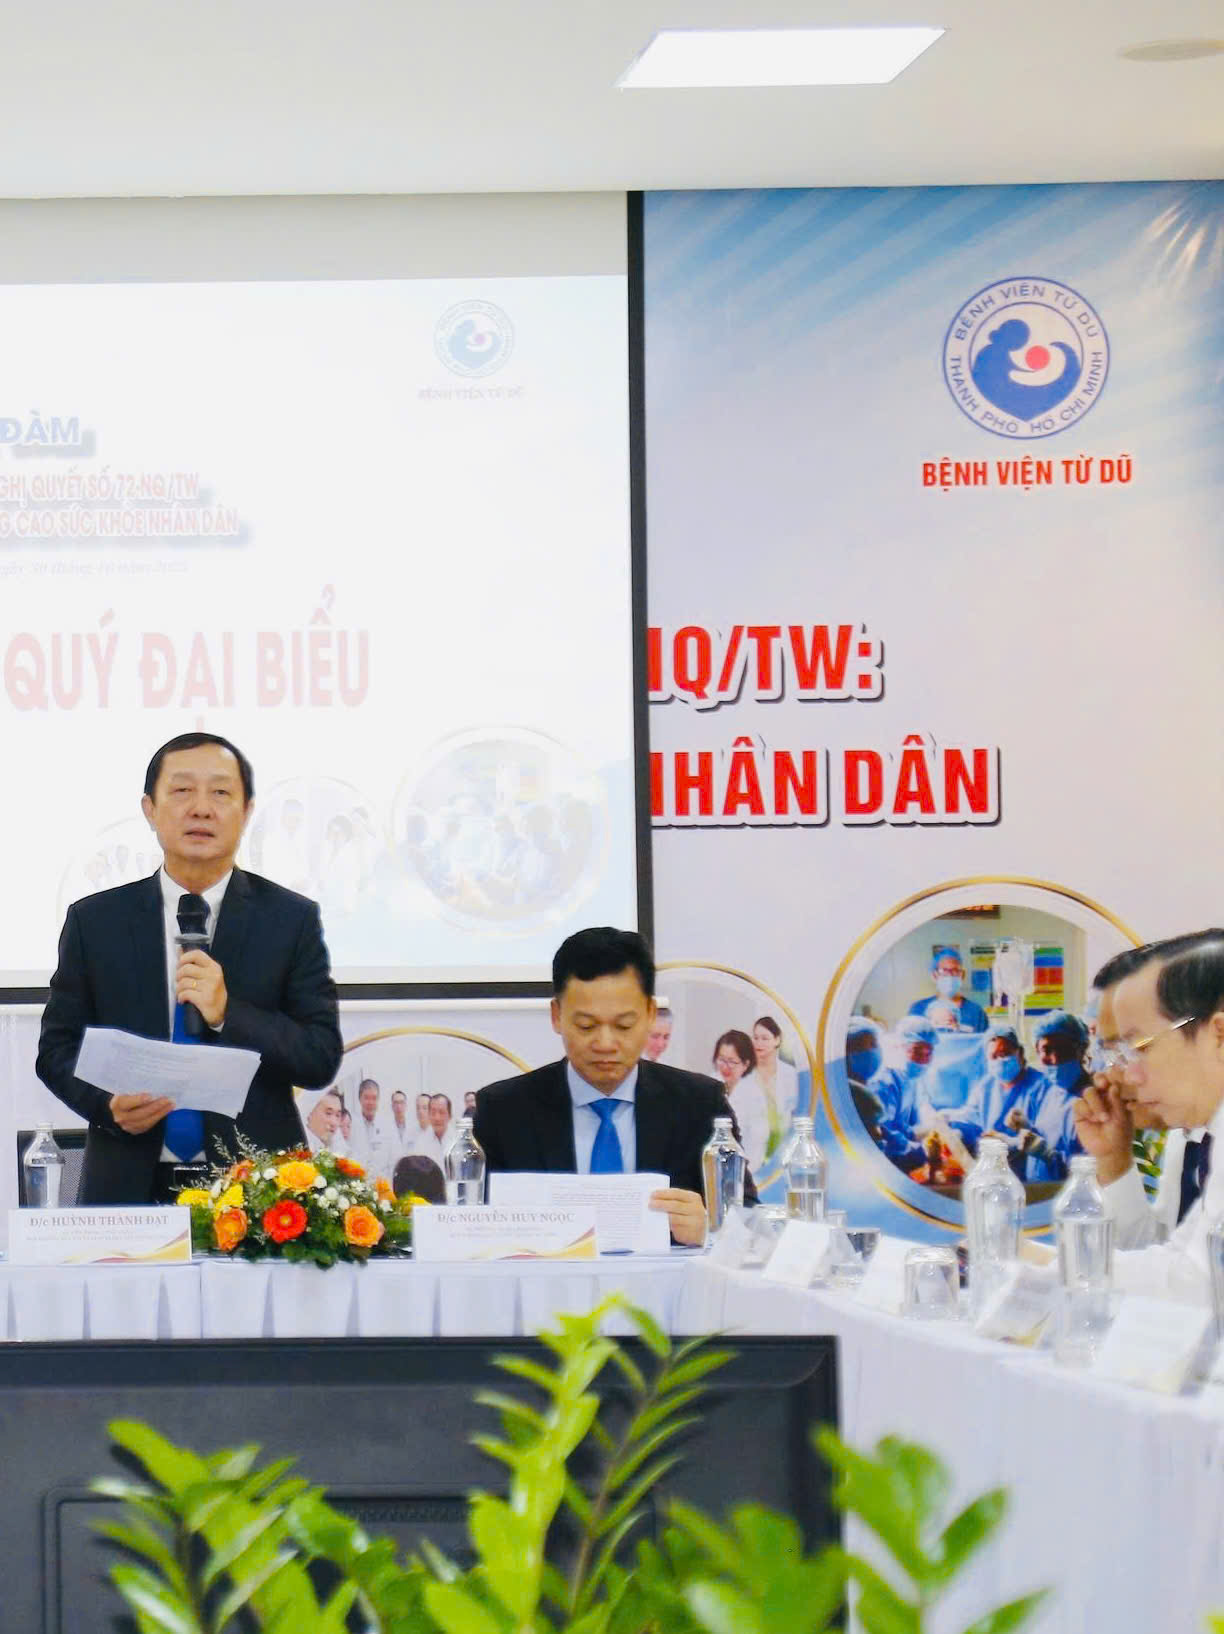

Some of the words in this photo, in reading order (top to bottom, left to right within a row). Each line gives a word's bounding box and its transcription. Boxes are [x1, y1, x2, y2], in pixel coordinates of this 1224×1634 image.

[1082, 351, 1103, 396] MINH
[922, 456, 988, 492] BỆNH
[996, 455, 1053, 490] VIỆN
[1061, 454, 1094, 485] TỪ
[1099, 453, 1132, 484] DŨ
[15, 510, 55, 536] CAO
[3, 607, 120, 711] QUÝ
[138, 631, 236, 731] ĐẠI
[255, 583, 371, 708] BIỂU
[843, 733, 990, 817] DÂN
